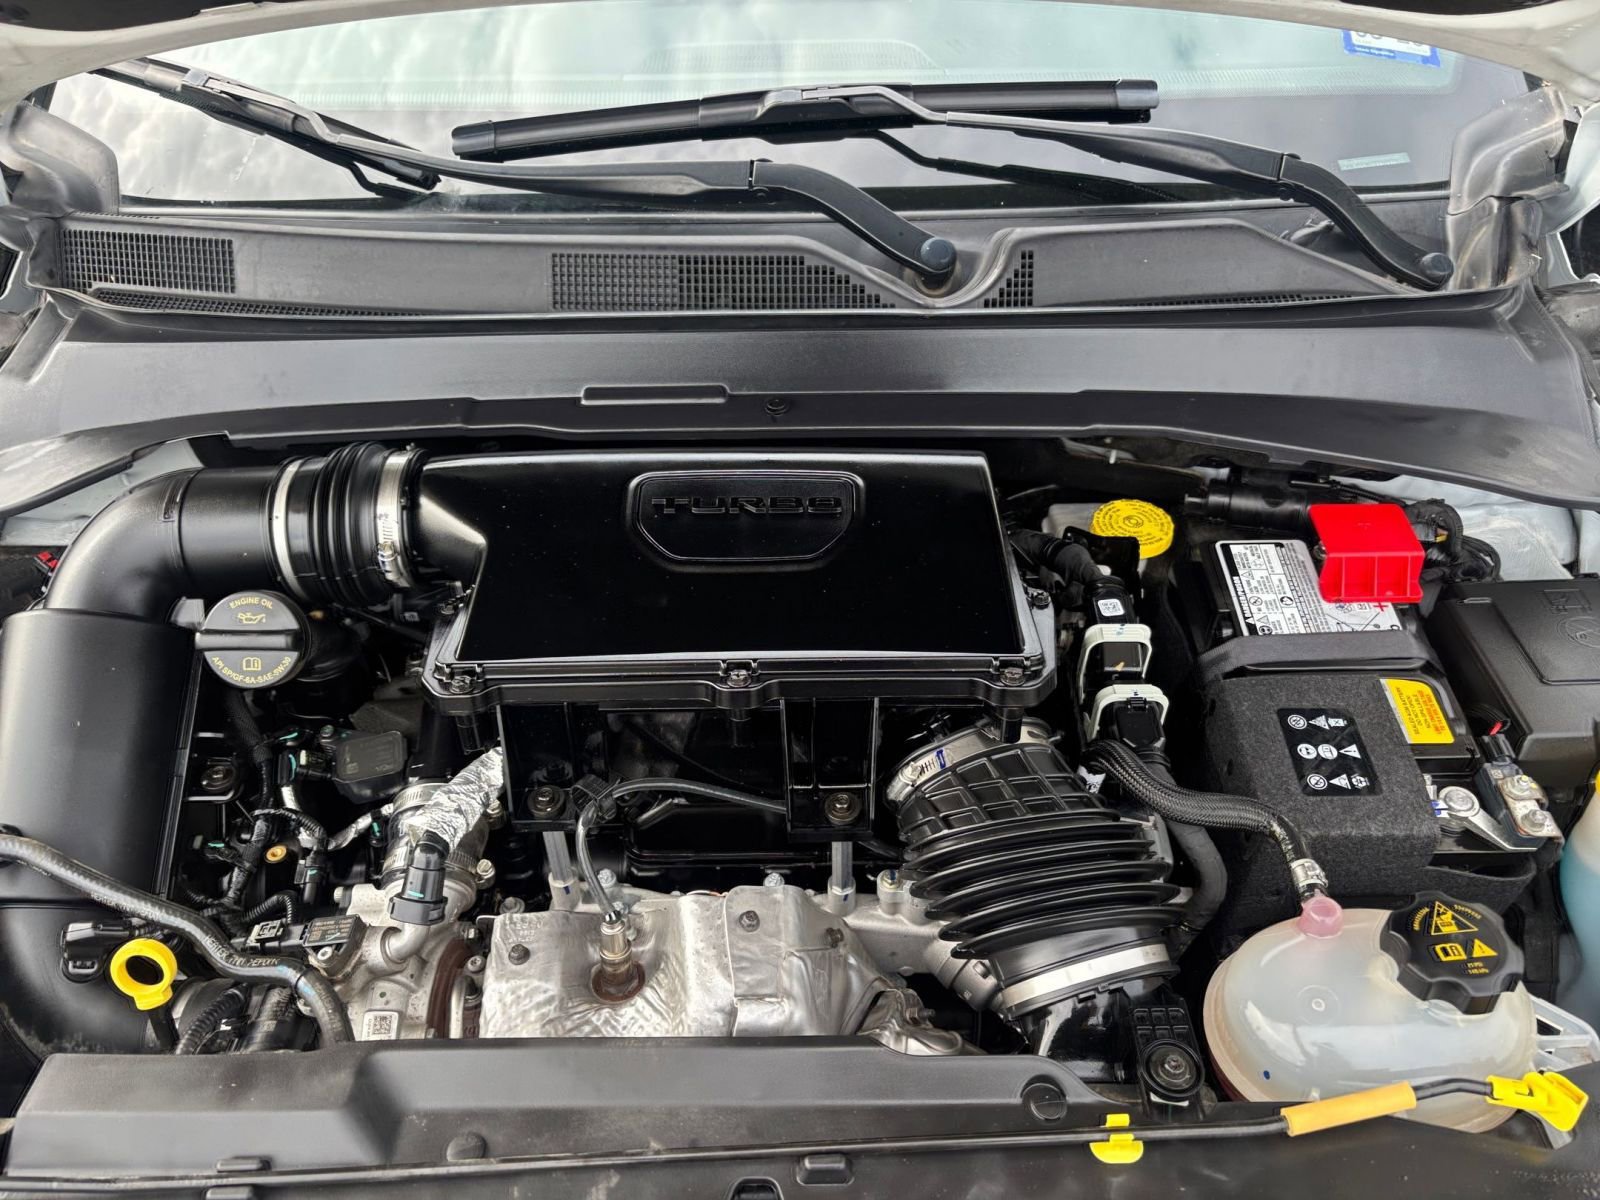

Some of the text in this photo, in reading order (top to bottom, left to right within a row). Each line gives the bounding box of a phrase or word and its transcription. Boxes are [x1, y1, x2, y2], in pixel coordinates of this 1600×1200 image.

[651, 496, 843, 514] TURBO
[229, 597, 274, 610] ENGINE OIL
[212, 656, 223, 669] API
